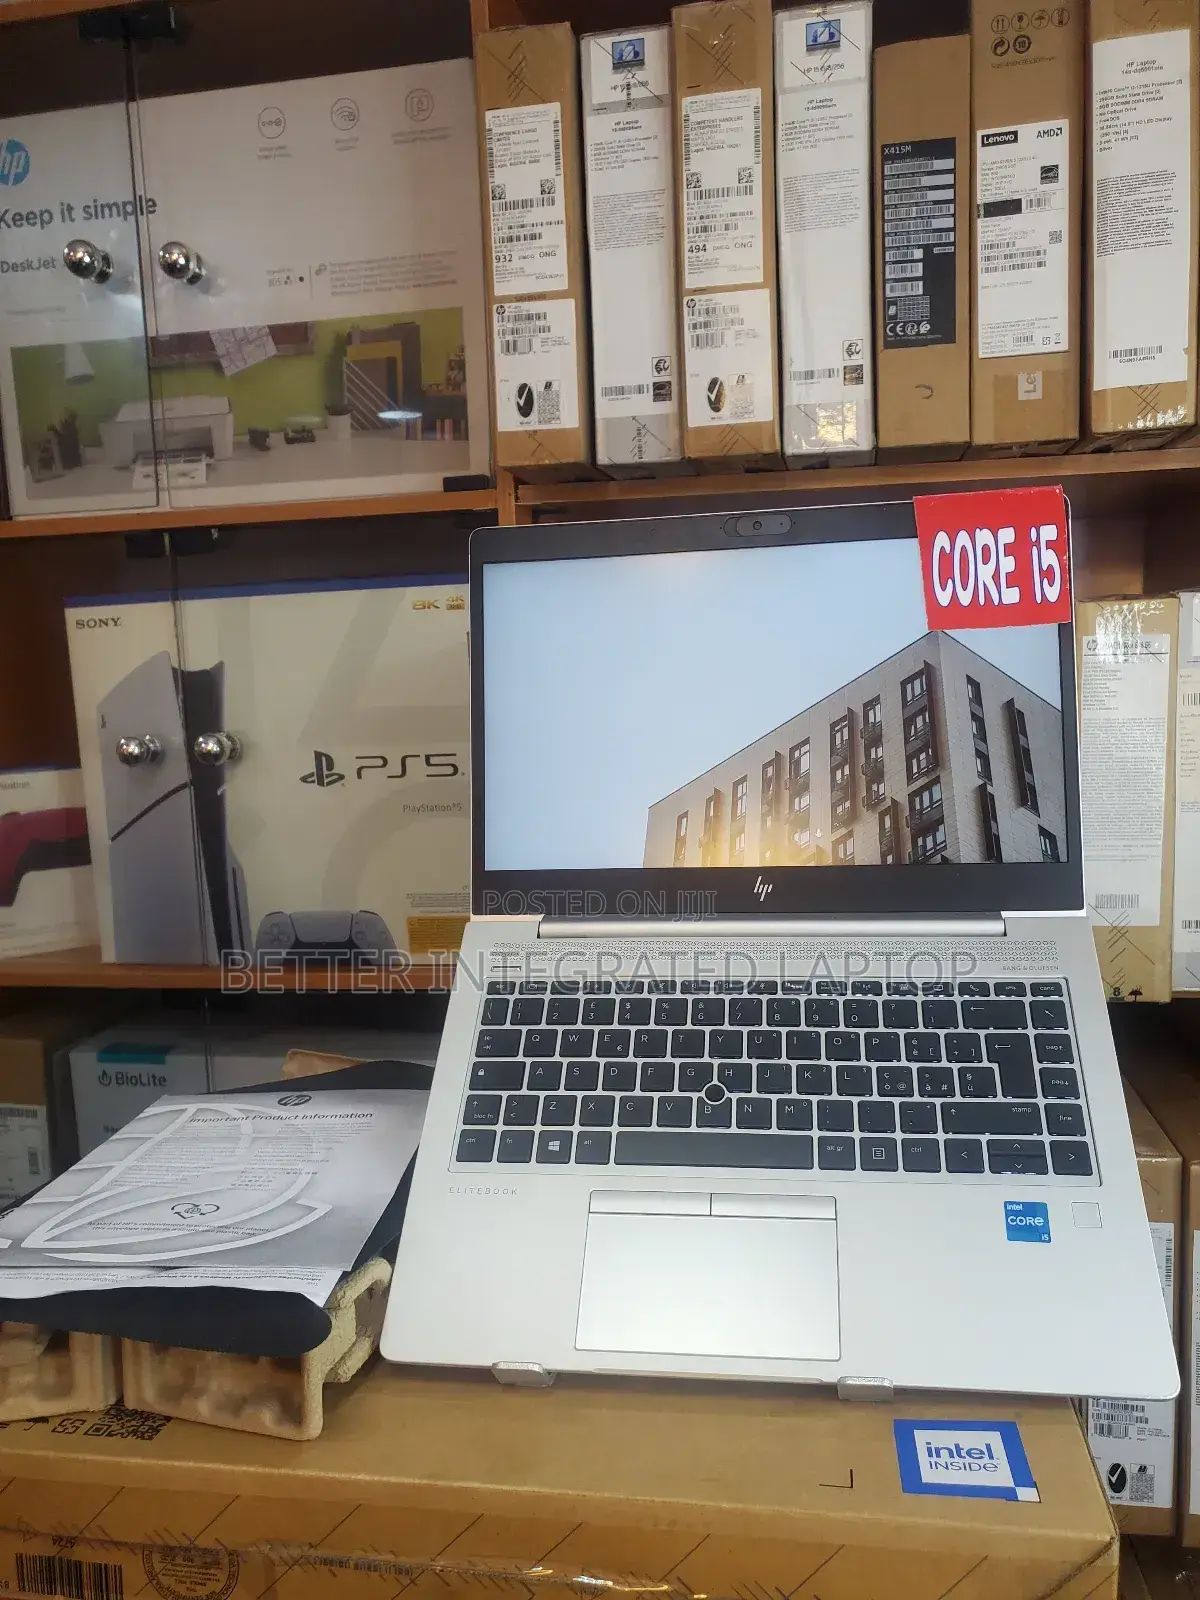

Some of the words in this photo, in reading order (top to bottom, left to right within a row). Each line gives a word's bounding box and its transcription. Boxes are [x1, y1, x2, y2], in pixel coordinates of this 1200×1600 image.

[1136, 59, 1157, 67] Laptop
[983, 132, 1015, 144] Lenovo
[1036, 128, 1056, 139] AMD
[883, 145, 912, 155] X415M
[0, 208, 54, 230] Keep
[60, 200, 76, 223] it
[82, 194, 158, 221] simple
[687, 243, 707, 254] 494
[734, 241, 753, 249] ONG
[494, 253, 513, 264] 932
[539, 250, 557, 258] ONG
[0, 257, 57, 273] DeskJet
[931, 526, 1021, 608] CORE
[1029, 524, 1062, 605] i5
[411, 599, 441, 610] 8K
[75, 616, 122, 630] SONY
[355, 752, 460, 779] PS5
[753, 875, 774, 902] hp
[531, 1034, 540, 1043] Q
[568, 1034, 580, 1042] W
[604, 1034, 611, 1042] E
[640, 1034, 648, 1043] R
[678, 1035, 685, 1043] T
[716, 1035, 724, 1043] Y
[754, 1036, 763, 1044] U
[833, 1037, 842, 1045] O
[535, 1067, 544, 1076] A
[573, 1067, 580, 1076] S
[610, 1067, 618, 1076] D
[647, 1068, 655, 1076] F
[686, 1068, 695, 1077] G
[725, 1069, 733, 1077] H
[763, 1069, 770, 1078] J
[804, 1070, 812, 1079] K
[844, 1072, 851, 1080] L
[114, 1071, 168, 1087] BioLite
[549, 1101, 557, 1110] Z
[587, 1101, 596, 1110] X
[626, 1102, 634, 1111] C
[665, 1102, 673, 1111] V
[704, 1105, 712, 1114] B
[744, 1104, 752, 1113] N
[785, 1105, 794, 1114] M
[190, 1114, 250, 1124] Important
[250, 1113, 299, 1121] Product
[301, 1112, 374, 1121] Information
[448, 1186, 518, 1196] ELITEBOOK
[1006, 1203, 1023, 1211] intel
[1041, 1233, 1049, 1241] i5
[925, 1440, 999, 1461] intel
